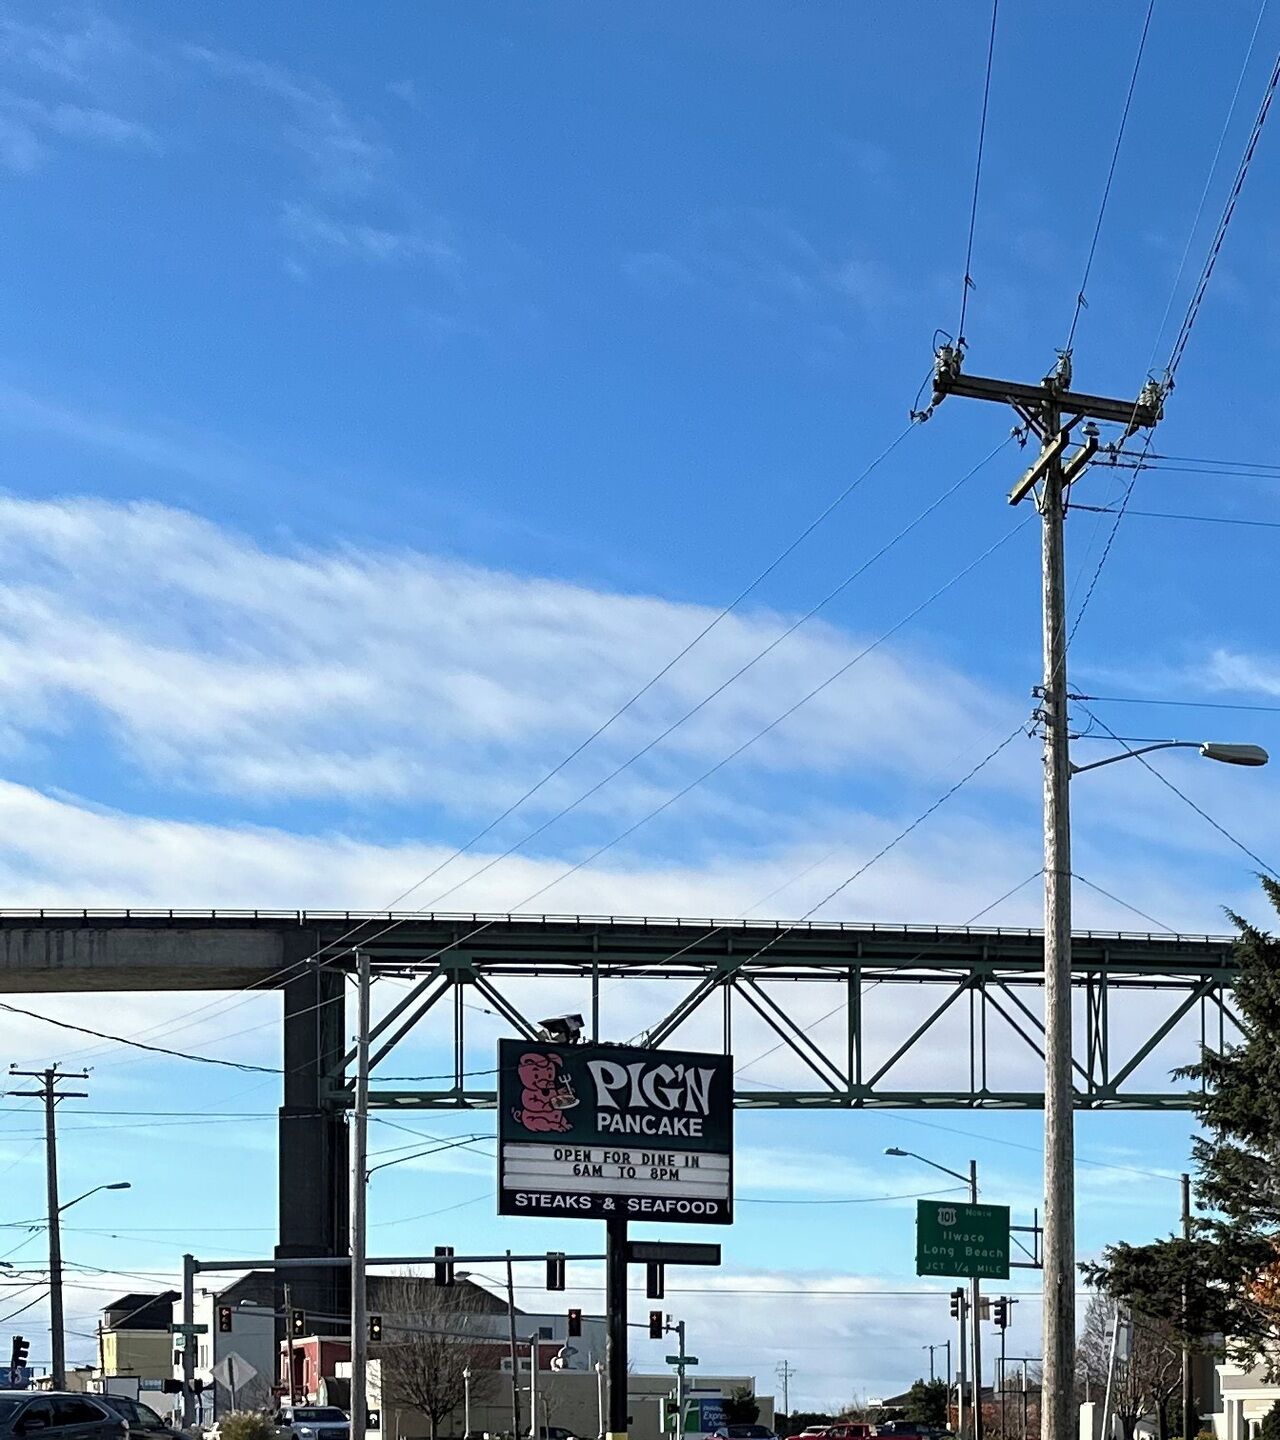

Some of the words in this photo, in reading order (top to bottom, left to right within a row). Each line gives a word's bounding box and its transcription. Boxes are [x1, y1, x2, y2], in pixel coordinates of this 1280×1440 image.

[587, 1060, 717, 1116] PIG'N
[597, 1112, 703, 1137] PANCAKE
[554, 1149, 591, 1162] OPEN
[603, 1151, 631, 1164] FOR
[642, 1153, 675, 1167] DINE
[685, 1156, 700, 1168] IN
[573, 1164, 603, 1178] 6AM
[618, 1166, 636, 1179] TO
[650, 1168, 680, 1181] 8PM
[515, 1193, 592, 1210] STEAKS
[603, 1197, 616, 1210] &
[627, 1199, 718, 1215] SEAFOOD
[941, 1211, 954, 1221] 101
[943, 1231, 985, 1243] Ilwaco
[924, 1244, 955, 1258] Long
[965, 1246, 1004, 1258] Beach
[926, 1262, 945, 1270] JCT
[977, 1264, 1002, 1274] MILE
